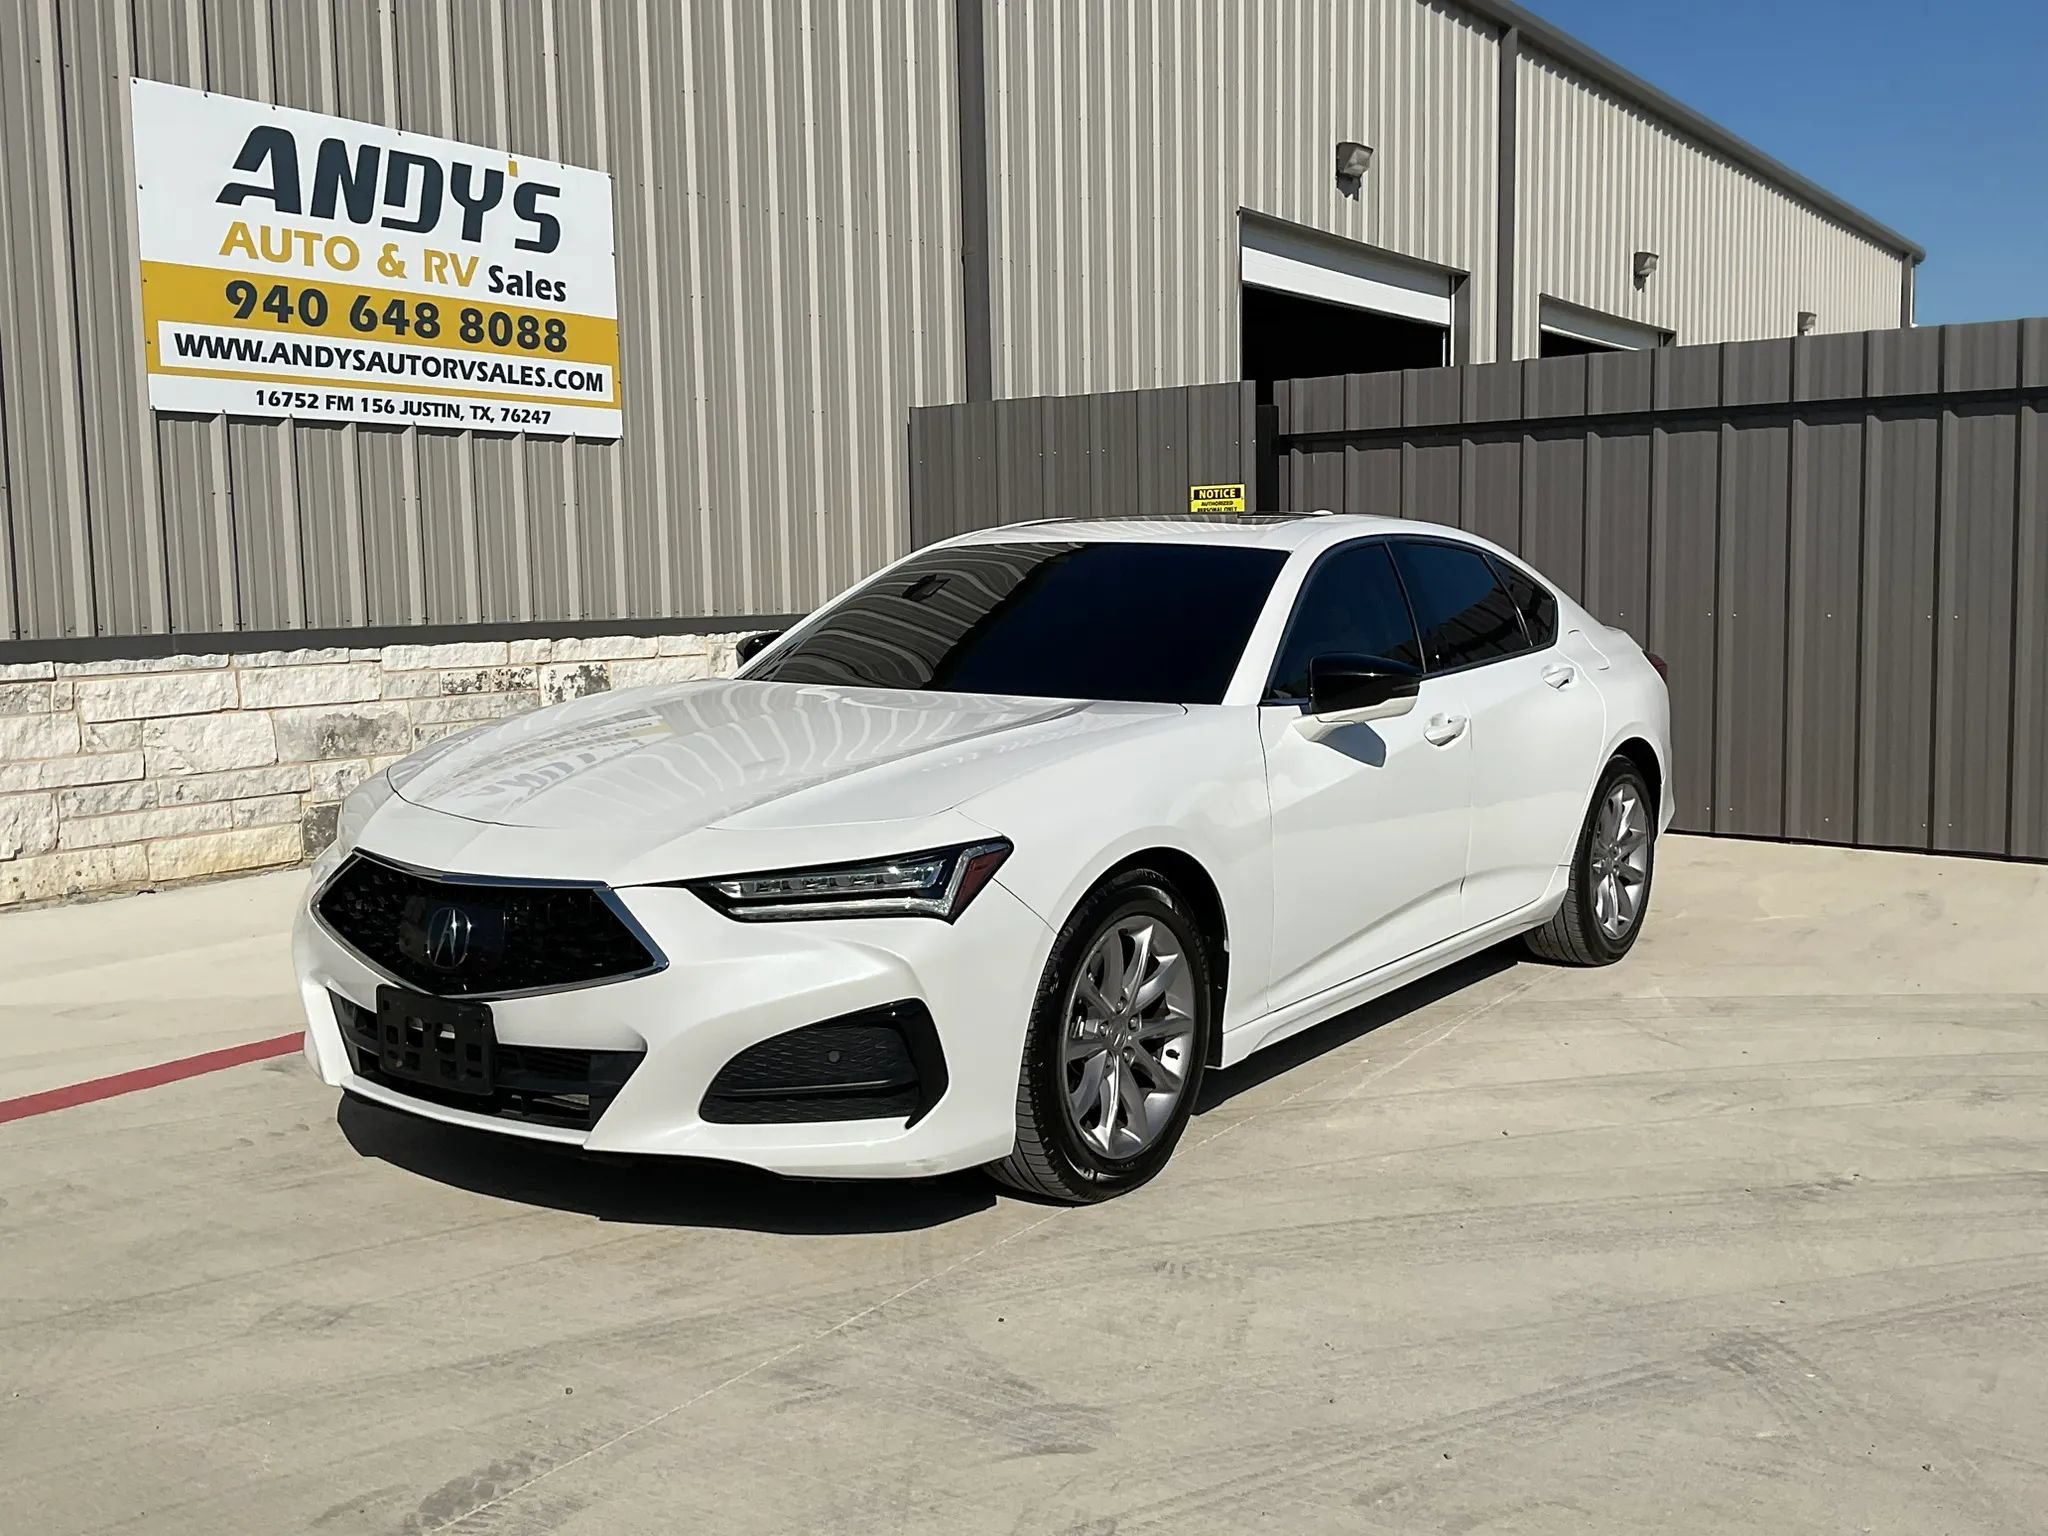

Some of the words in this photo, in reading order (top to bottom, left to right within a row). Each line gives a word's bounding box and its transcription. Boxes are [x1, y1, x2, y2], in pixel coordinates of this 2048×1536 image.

[215, 125, 561, 254] ANDY'S
[218, 221, 360, 272] AUTO
[376, 242, 406, 279] &
[424, 249, 480, 287] RV
[488, 265, 567, 302] Sales
[225, 280, 328, 327] 940
[349, 295, 441, 339] 648
[459, 308, 568, 353] 8088
[174, 332, 604, 393] WWW.ANDYSAUTORVSALES.COM
[255, 389, 319, 410] 16752
[325, 394, 355, 412] FM
[361, 397, 395, 416] 156
[399, 400, 465, 421] JUSTIN,
[469, 405, 496, 424] TX,
[500, 407, 552, 425] 76247
[1199, 488, 1236, 499] NOTICE
